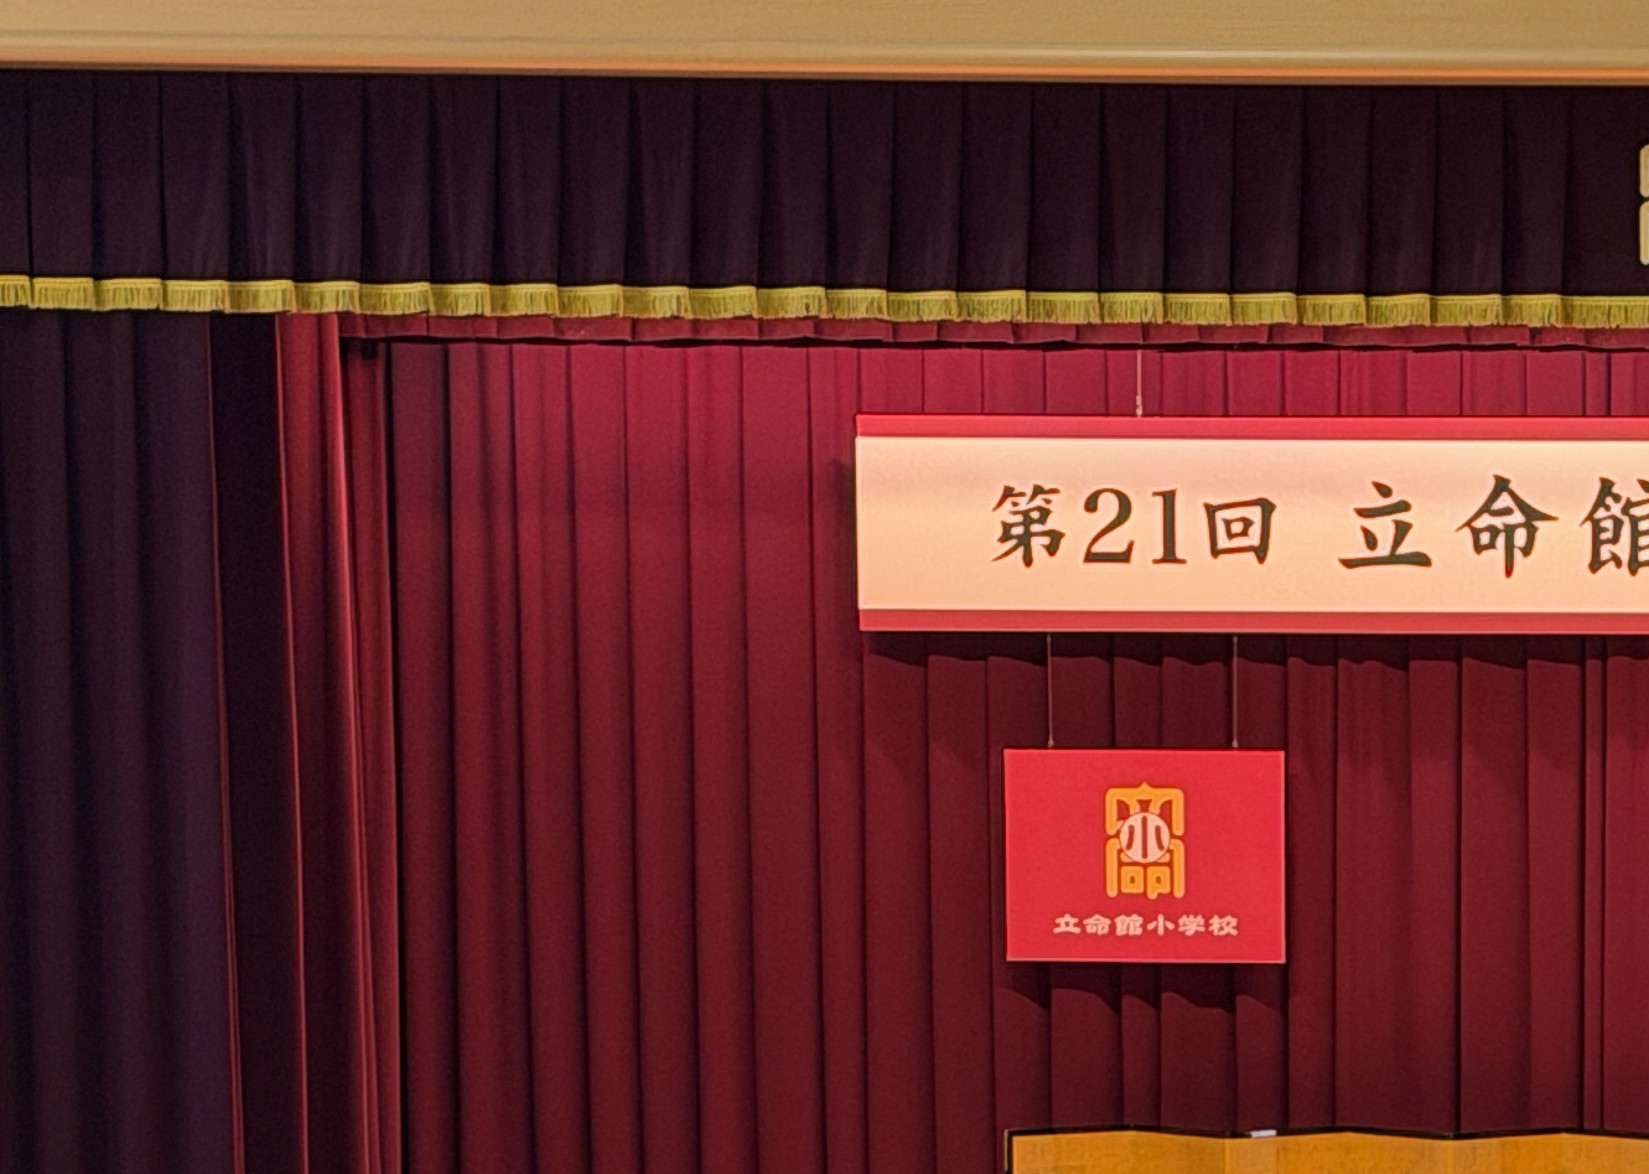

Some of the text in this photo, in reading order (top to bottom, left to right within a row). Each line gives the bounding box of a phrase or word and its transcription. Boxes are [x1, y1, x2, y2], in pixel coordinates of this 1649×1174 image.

[992, 484, 1277, 569] 第21回
[1052, 913, 1239, 937] 立命館小学校
